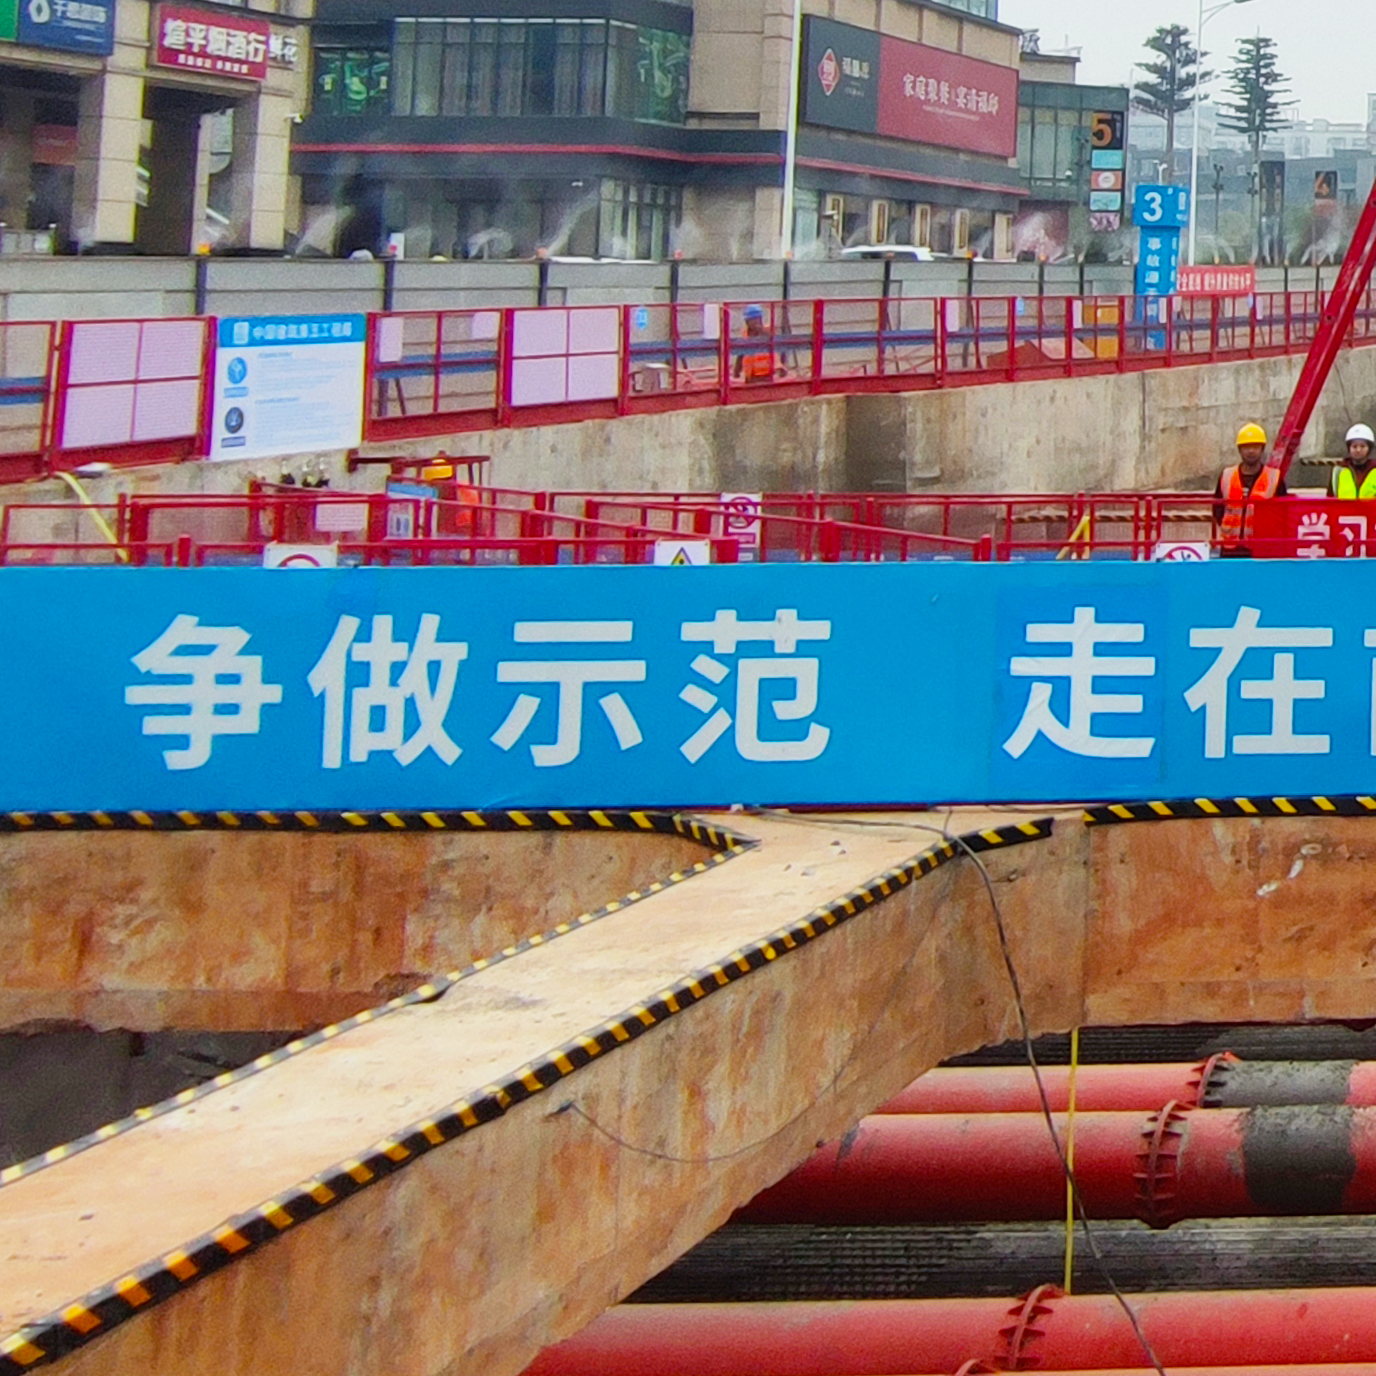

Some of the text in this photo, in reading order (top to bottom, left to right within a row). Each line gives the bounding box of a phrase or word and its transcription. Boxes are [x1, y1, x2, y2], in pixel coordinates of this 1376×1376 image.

[1142, 191, 1163, 222] 3
[124, 610, 832, 770] 争做示范
